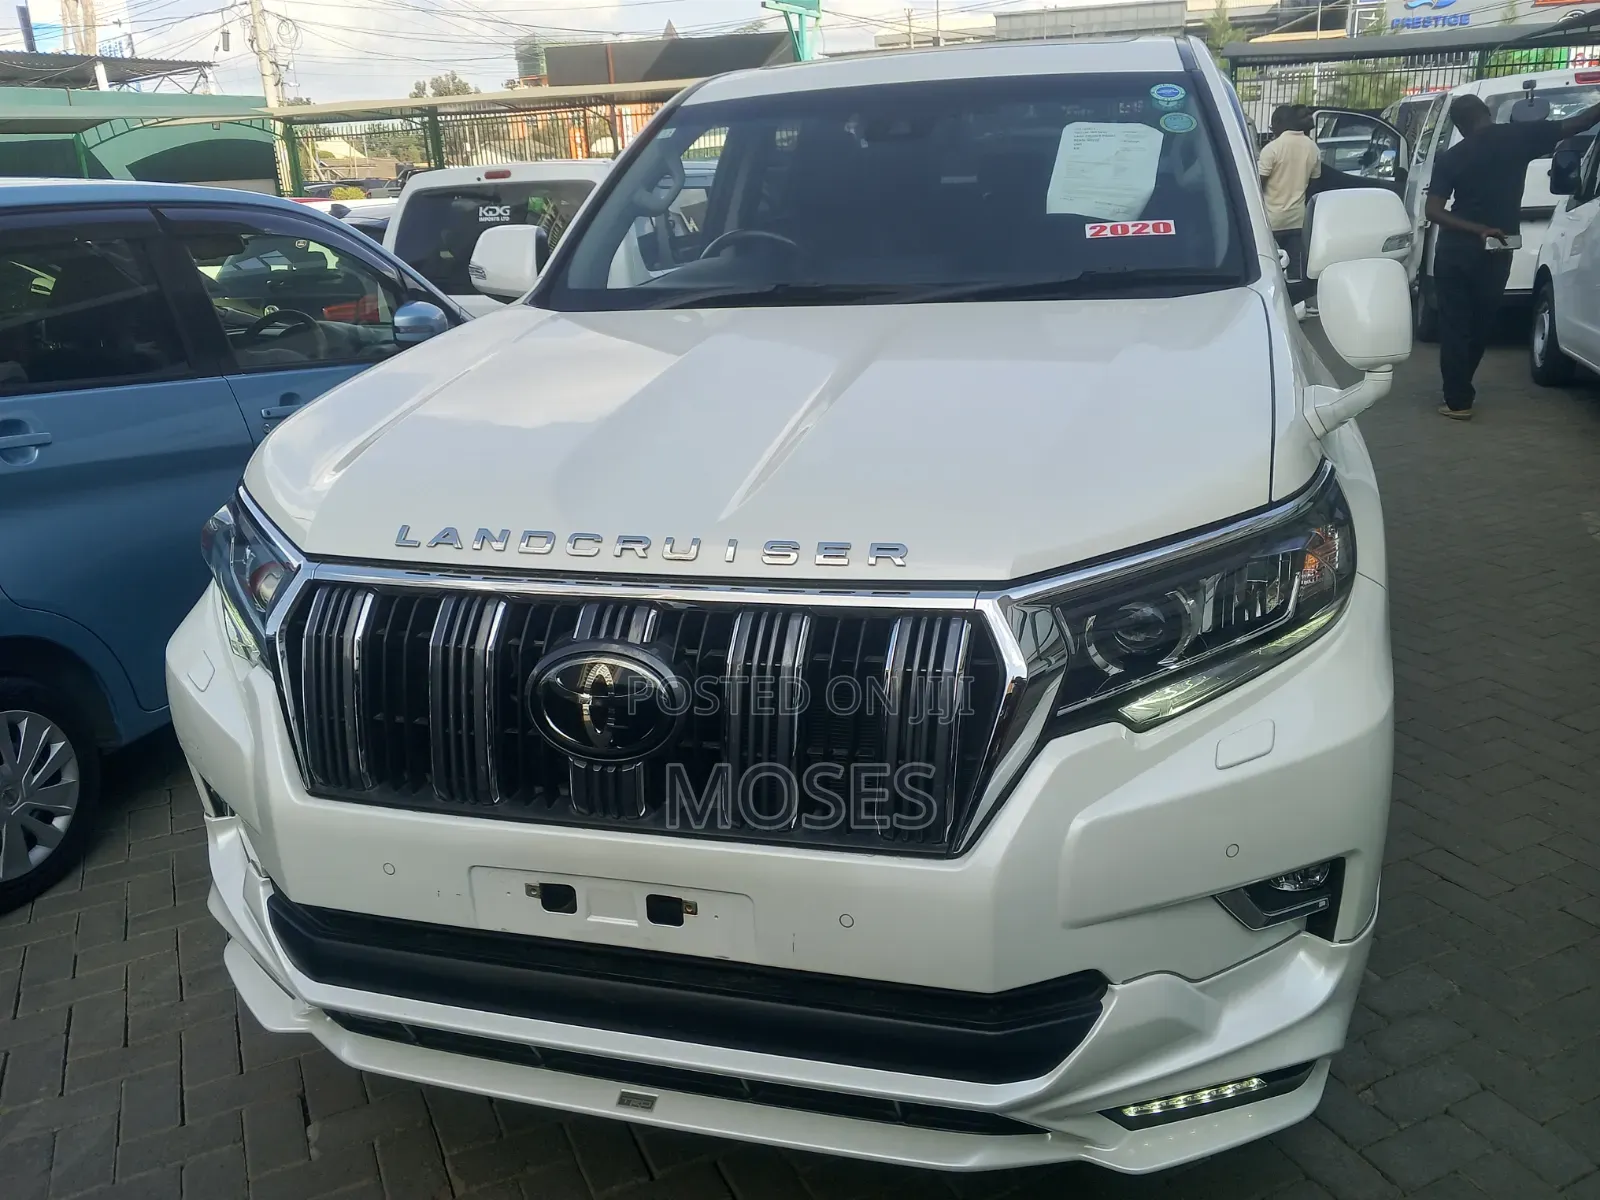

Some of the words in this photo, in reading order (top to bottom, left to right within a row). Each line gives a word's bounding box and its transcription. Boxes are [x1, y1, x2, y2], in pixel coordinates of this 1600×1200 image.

[1391, 13, 1470, 29] PRESTIGE
[479, 205, 510, 217] KDG
[1089, 221, 1172, 237] 2020
